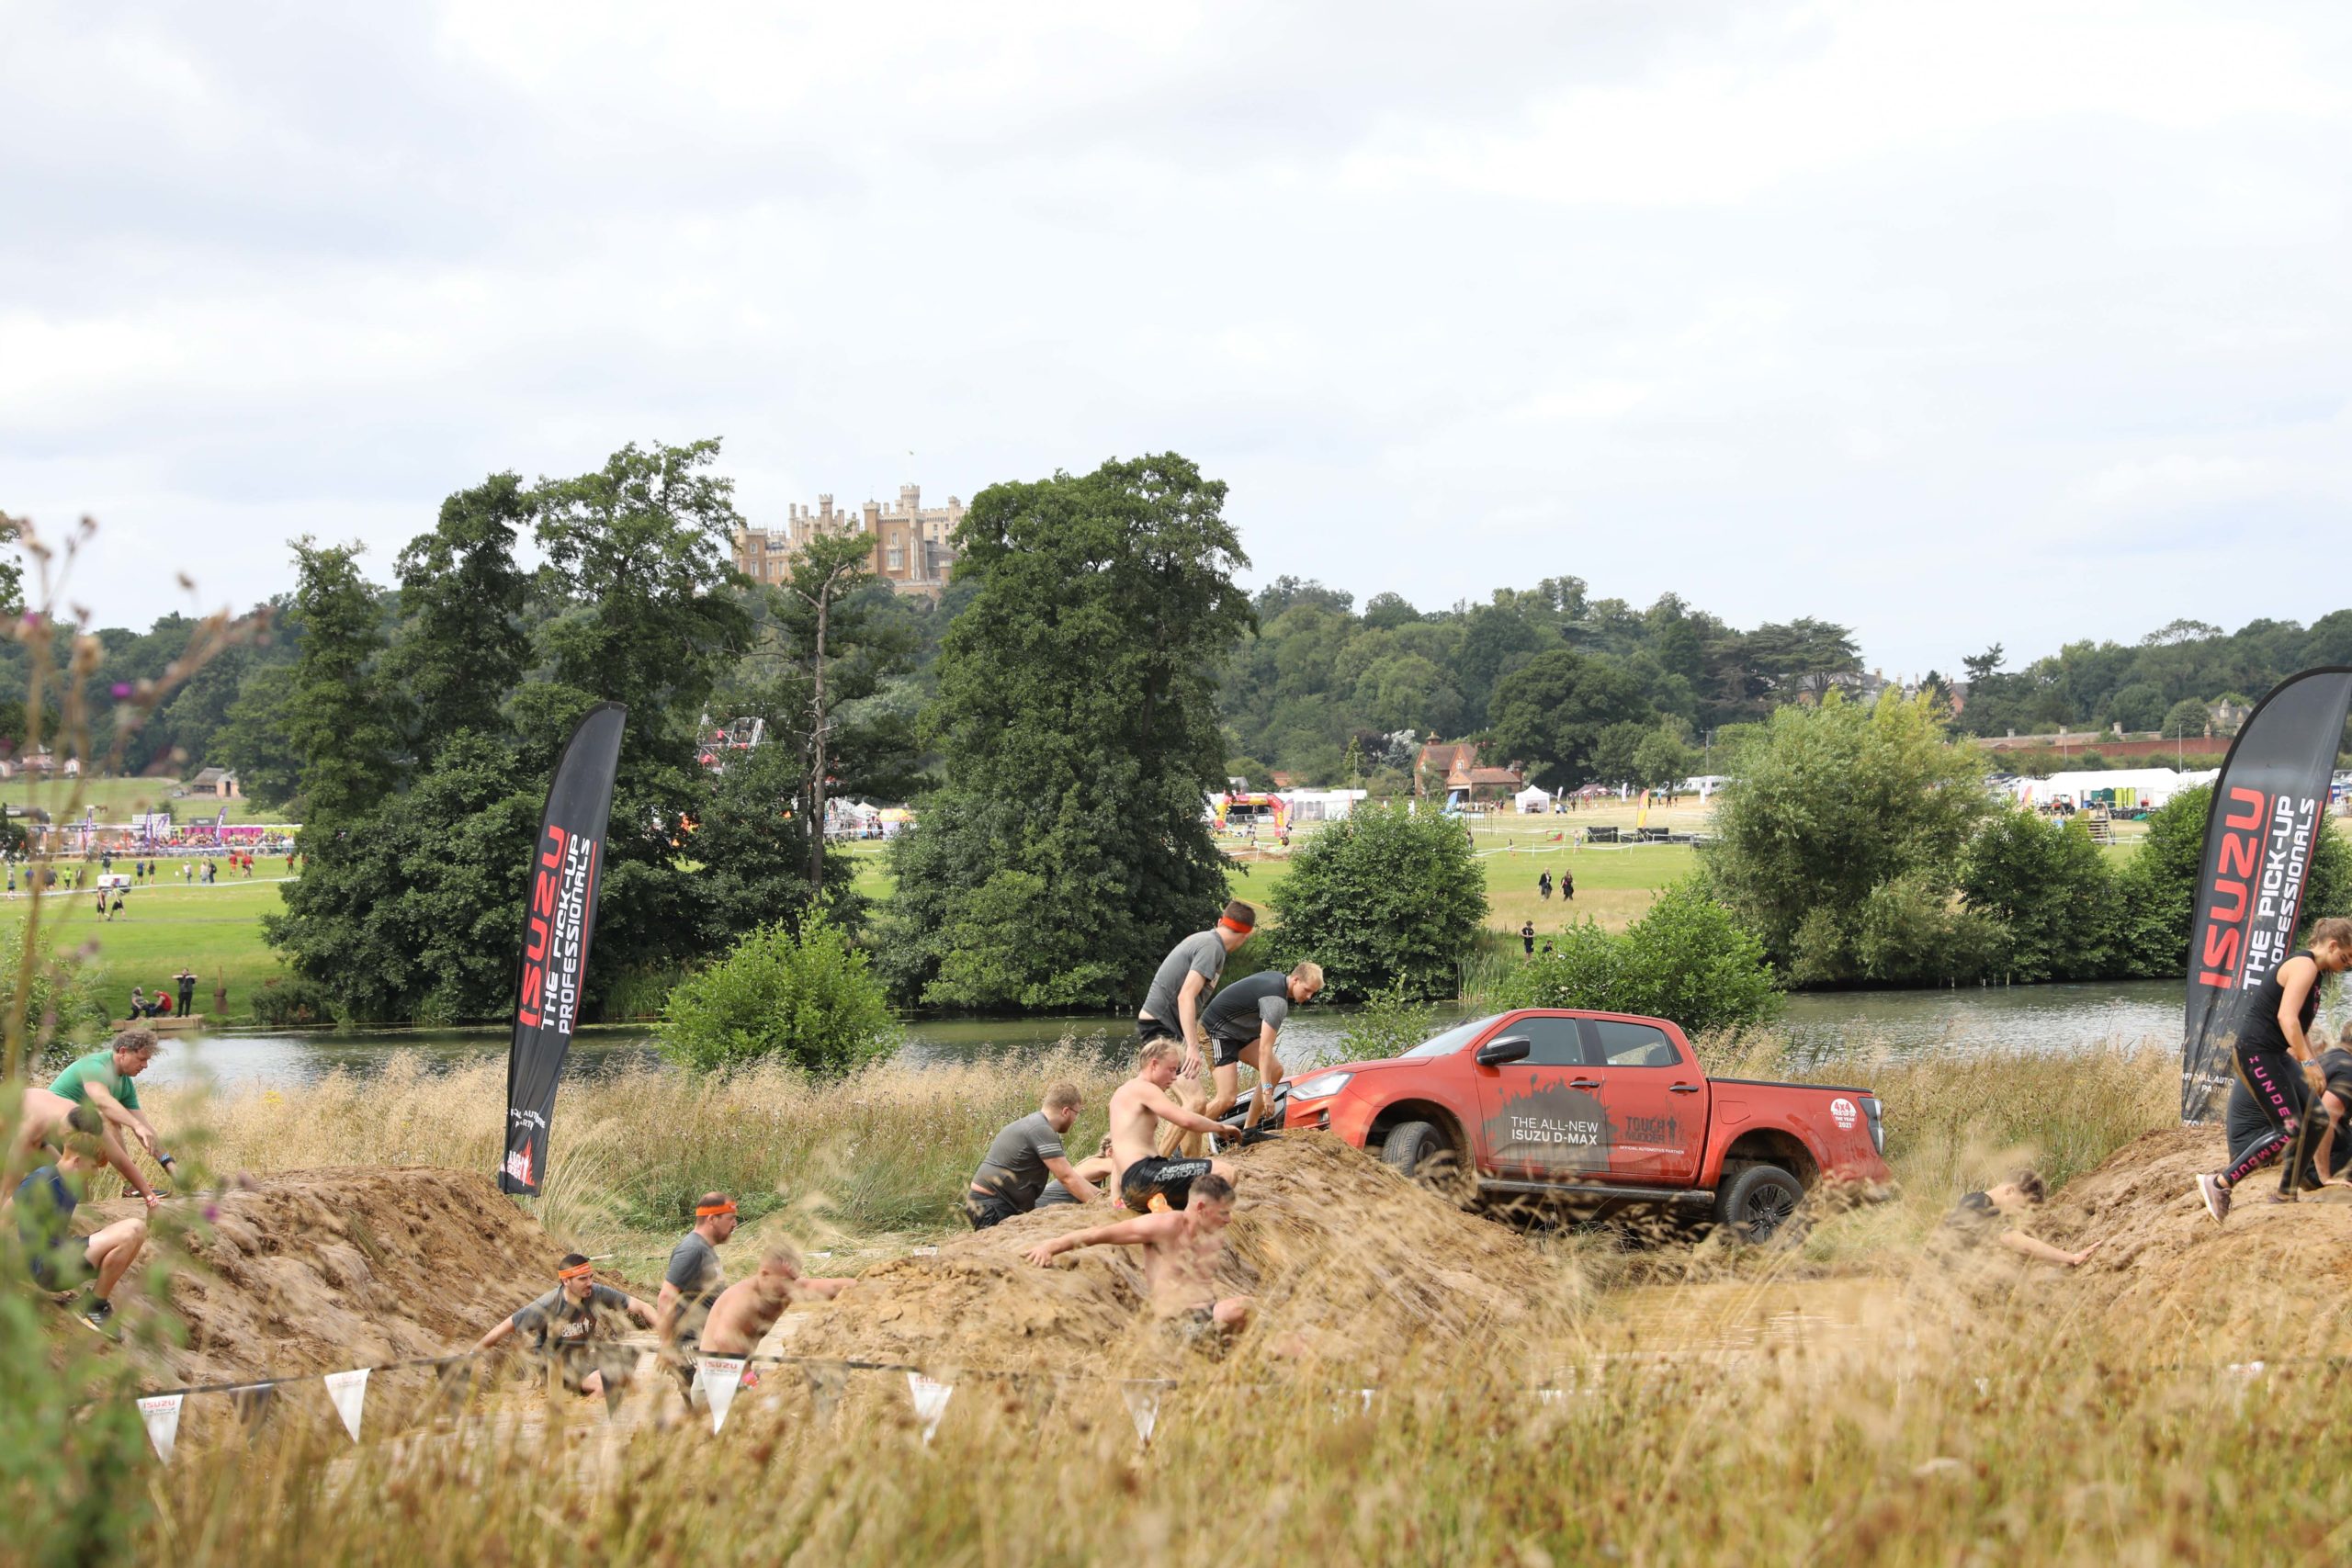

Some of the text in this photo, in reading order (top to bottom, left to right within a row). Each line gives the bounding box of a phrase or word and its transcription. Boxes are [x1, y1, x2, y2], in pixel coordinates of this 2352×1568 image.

[2199, 787, 2265, 988] ISUZU
[2243, 795, 2295, 990] THE PICK-UP
[519, 824, 565, 1026] ISUZU
[559, 838, 591, 1034] PROFESSIONALS
[541, 971, 559, 1030] THE
[1510, 1116, 1599, 1133] THE ALL-NEW
[1511, 1129, 1598, 1145] ISUZU D-MAX
[2230, 1134, 2291, 1180] ARMOUR
[705, 1360, 738, 1369] ISUZU
[143, 1399, 175, 1409] ISUZU
